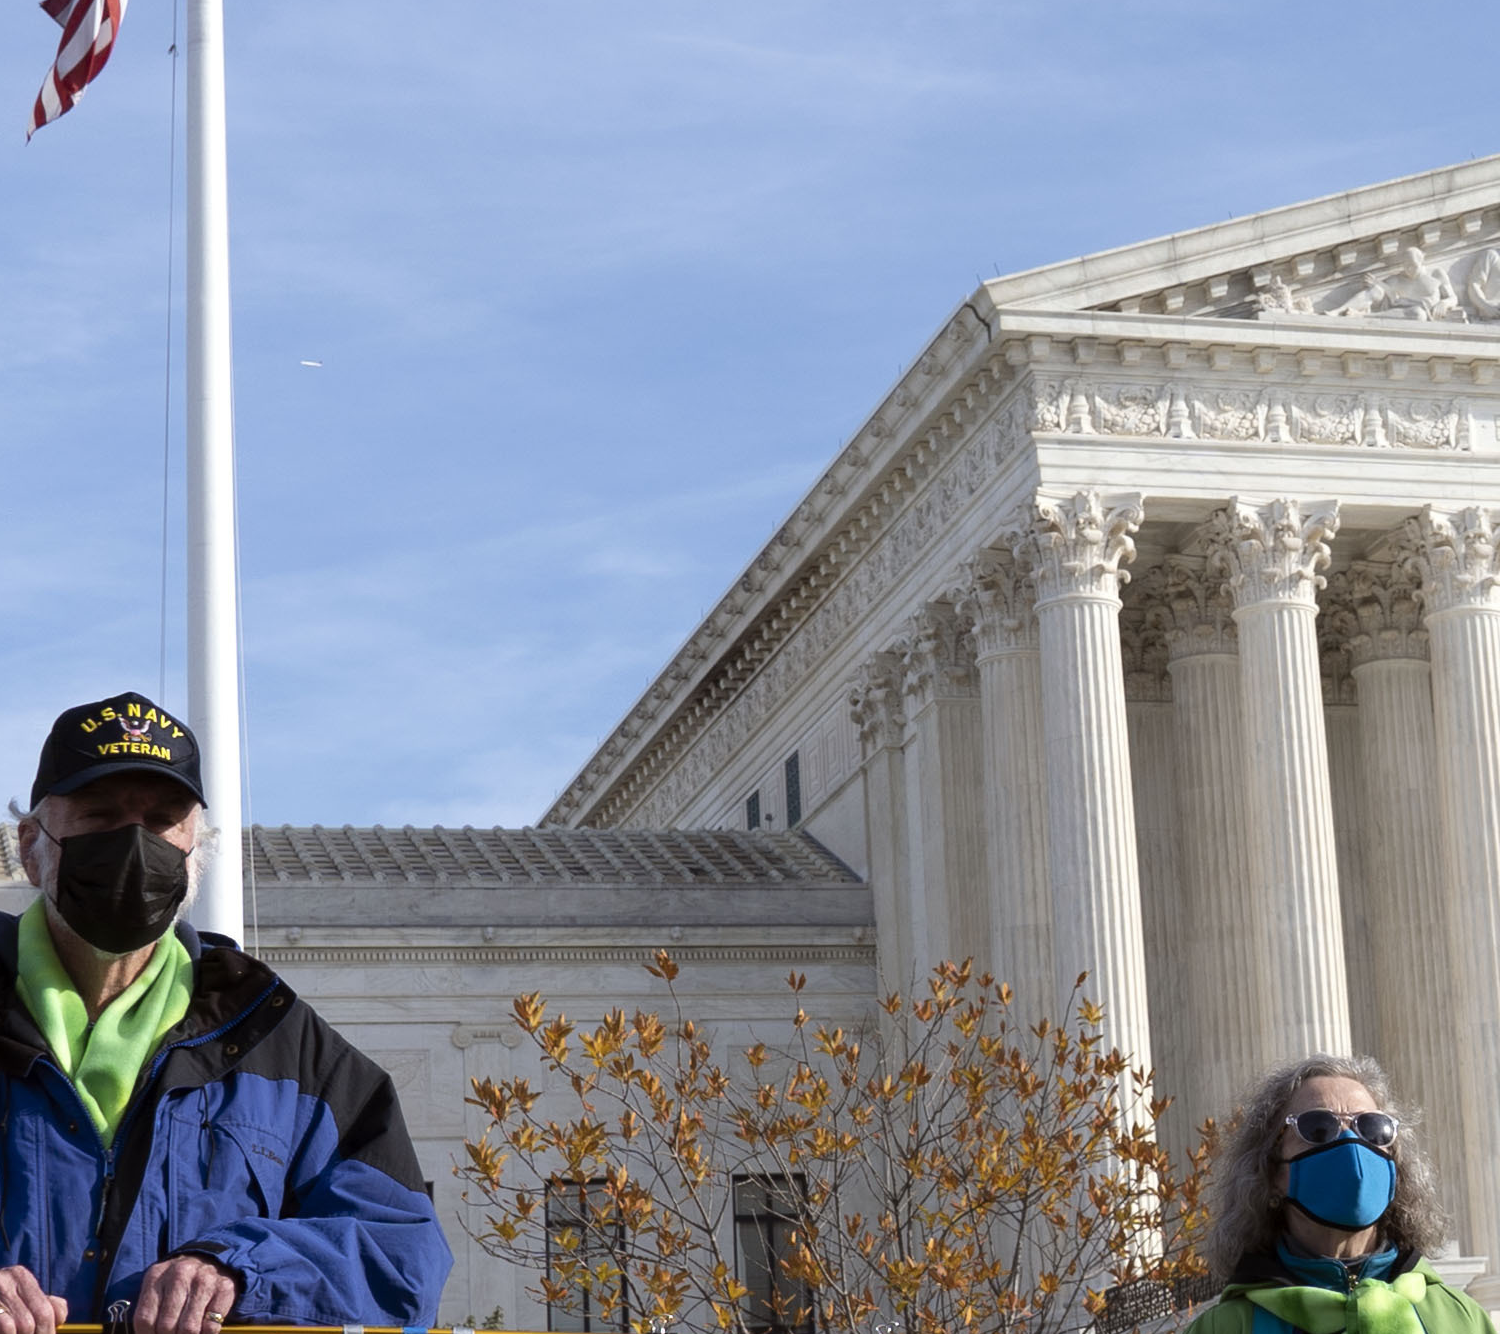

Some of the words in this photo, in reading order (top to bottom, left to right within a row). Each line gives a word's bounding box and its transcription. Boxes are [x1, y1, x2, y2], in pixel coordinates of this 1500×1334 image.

[81, 707, 122, 734] U.S.
[127, 703, 185, 739] NAVY
[97, 742, 171, 761] VETERAN
